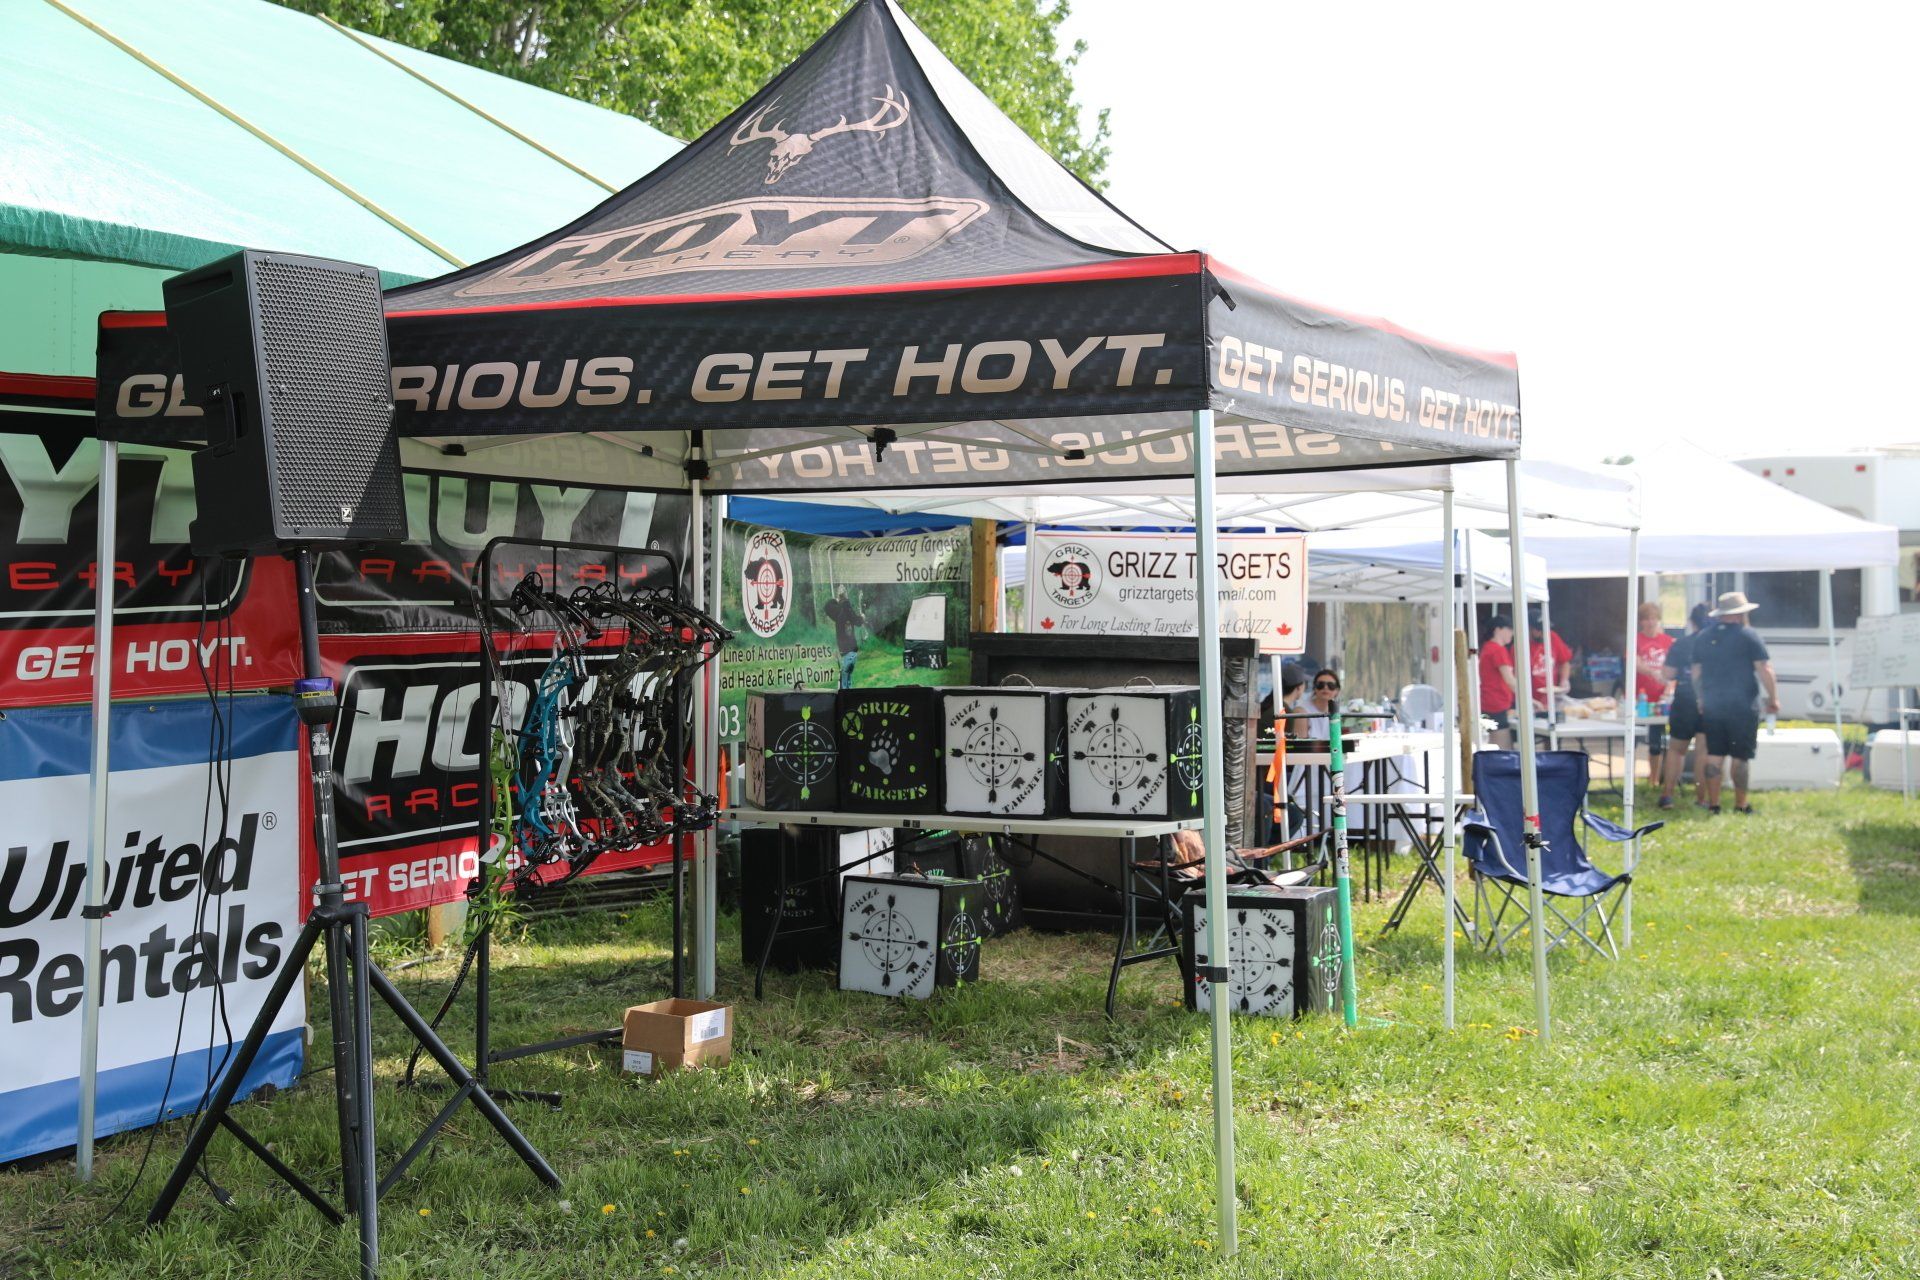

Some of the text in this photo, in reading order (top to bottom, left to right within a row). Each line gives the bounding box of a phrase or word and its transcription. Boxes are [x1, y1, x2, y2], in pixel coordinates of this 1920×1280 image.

[506, 208, 947, 278] HOYT
[515, 248, 875, 286] ARCHERY
[391, 356, 652, 412] RIOUS.
[691, 348, 869, 403] GET
[893, 333, 1173, 396] HOYT.
[1218, 335, 1517, 440] GET SERIOUS. GET HOYT.
[753, 532, 783, 554] GRIZZ
[920, 536, 960, 556] Targets
[1055, 546, 1090, 559] GRIZZ
[897, 562, 933, 582] Shoot
[1108, 552, 1291, 580] GRIZZ TRGETS
[1052, 588, 1092, 605] TARGETS
[1119, 586, 1276, 603] grizztargetsmail.com
[749, 608, 785, 634] TARGETS
[1060, 615, 1080, 630] For
[1081, 616, 1109, 635] Long
[1110, 617, 1151, 635] Lasting
[1153, 617, 1193, 636] Targets
[126, 636, 252, 673] HOYT.
[723, 643, 832, 663] Line of Archery Targets
[738, 670, 764, 687] Head
[767, 669, 775, 686] &
[777, 667, 803, 684] Field
[806, 666, 834, 683] Point
[857, 701, 911, 718] GRIZZ
[950, 700, 981, 727] GRIZZ
[1070, 702, 1098, 734] GRIZZ
[851, 780, 928, 801] TARGETS
[1002, 767, 1043, 815] TARGETS
[1130, 767, 1168, 815] TARGETS
[0, 813, 260, 928] United
[850, 887, 880, 913] GRIZZ
[0, 904, 283, 1024] Rentals
